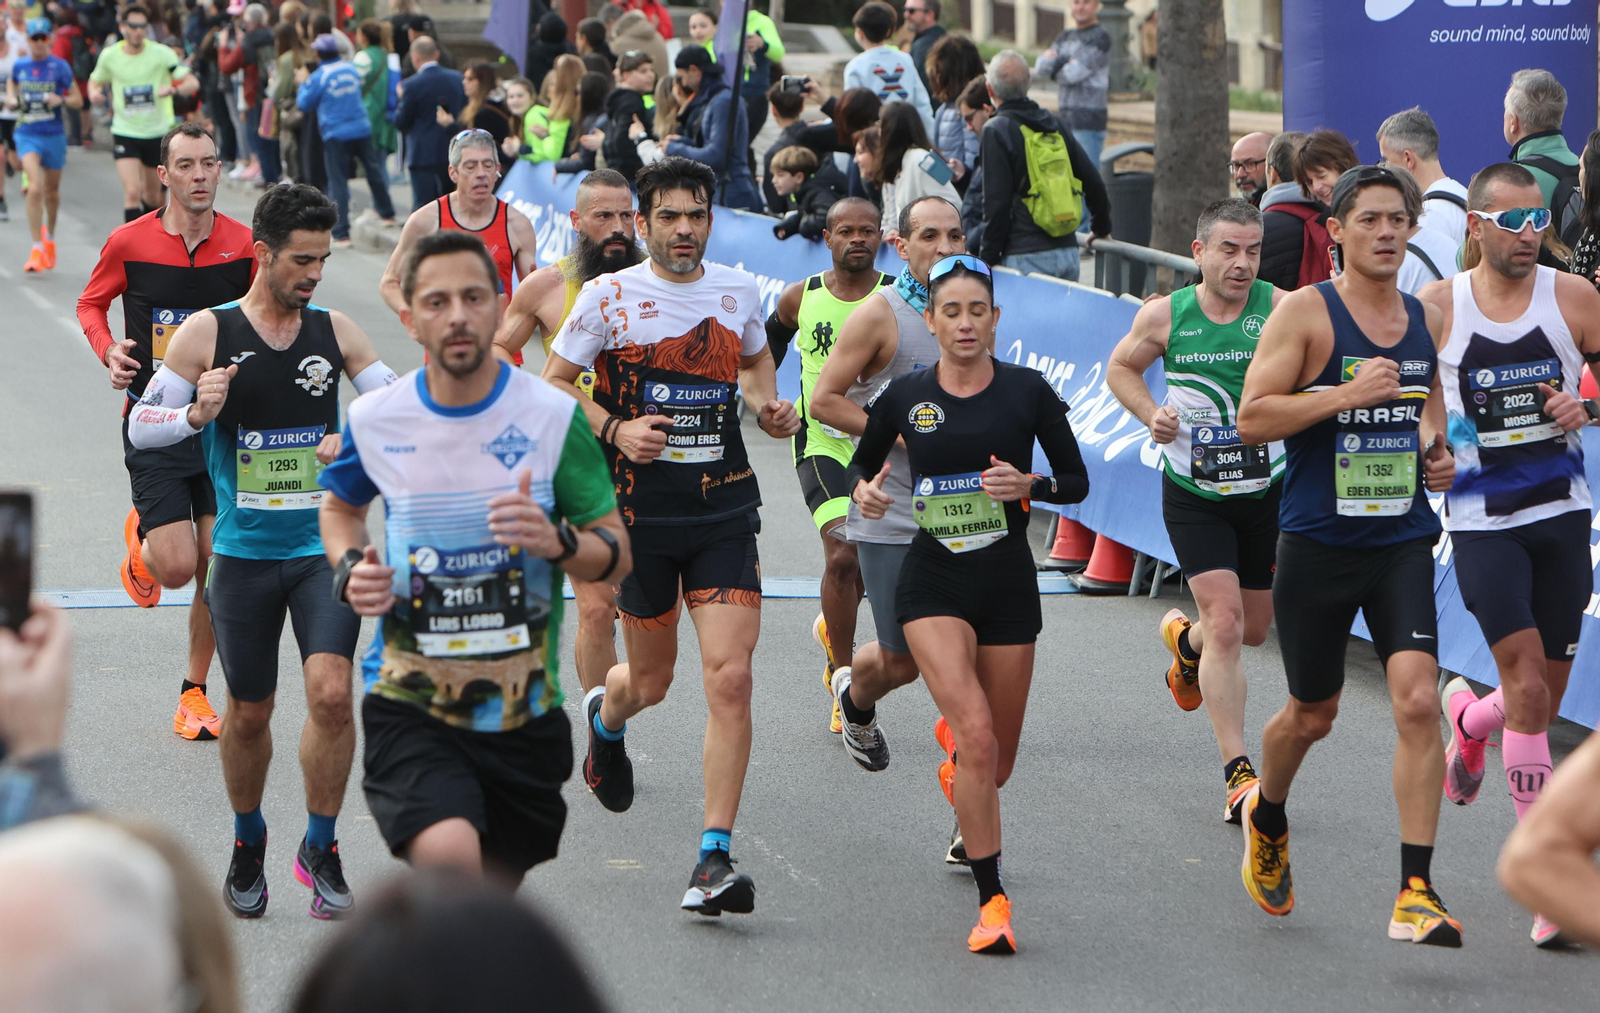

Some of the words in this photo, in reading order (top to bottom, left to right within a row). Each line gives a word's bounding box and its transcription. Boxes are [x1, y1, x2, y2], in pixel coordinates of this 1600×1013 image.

[1429, 25, 1484, 43] sound
[1485, 24, 1527, 44] mind,
[1530, 24, 1570, 42] sound
[1570, 23, 1591, 45] body
[1174, 349, 1254, 364] #retoyosipu
[1404, 362, 1428, 371] RRT
[1500, 364, 1550, 381] ZURICH
[676, 388, 720, 400] ZURICH
[1502, 393, 1536, 409] 2022
[673, 414, 701, 428] 2224
[1190, 411, 1212, 419] JOSE
[1338, 405, 1421, 424] BRASIL
[1504, 413, 1540, 428] MOSHE
[268, 432, 316, 446] ZURICH
[668, 434, 696, 446] COMO
[698, 434, 720, 445] ERES
[1218, 430, 1239, 440] ZUR
[1366, 438, 1410, 448] ZURICH
[1217, 451, 1242, 465] 3064
[268, 459, 298, 472] 1293
[1365, 464, 1393, 477] 1352
[1218, 469, 1244, 480] ELIAS
[265, 480, 302, 491] JUANDI
[1347, 486, 1371, 496] EDER
[1374, 485, 1410, 496] ISICAWA
[943, 503, 973, 516] 1312
[962, 518, 1002, 533] FERRÃO
[444, 548, 510, 572] ZURICH
[442, 586, 484, 608] 2161
[428, 616, 460, 632] LUIS
